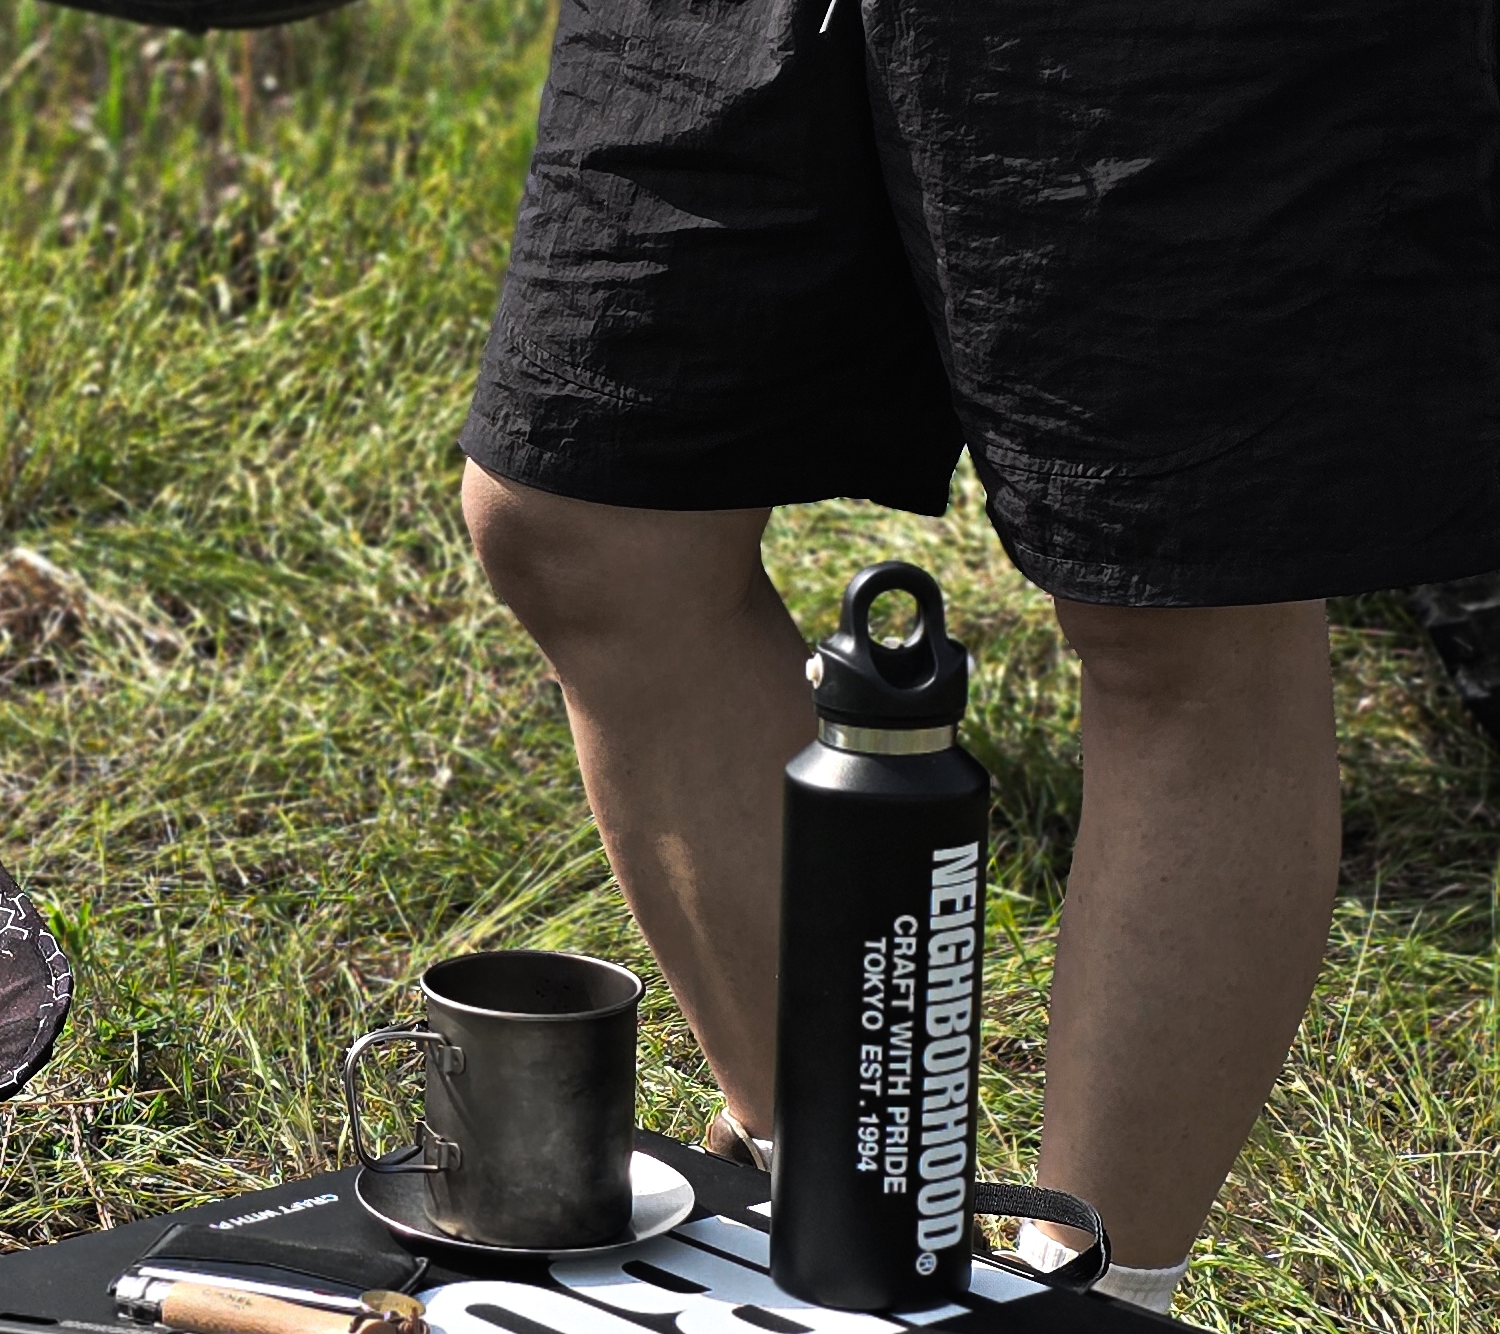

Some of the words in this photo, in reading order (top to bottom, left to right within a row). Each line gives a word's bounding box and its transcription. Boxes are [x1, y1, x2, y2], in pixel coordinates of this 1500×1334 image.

[861, 937, 887, 1031] TOKYO
[890, 914, 918, 1013] CRAFT
[888, 1021, 914, 1097] WITH
[857, 1112, 880, 1172] 1994
[883, 1107, 910, 1194] PRIDE
[278, 1193, 339, 1214] CRAFT
